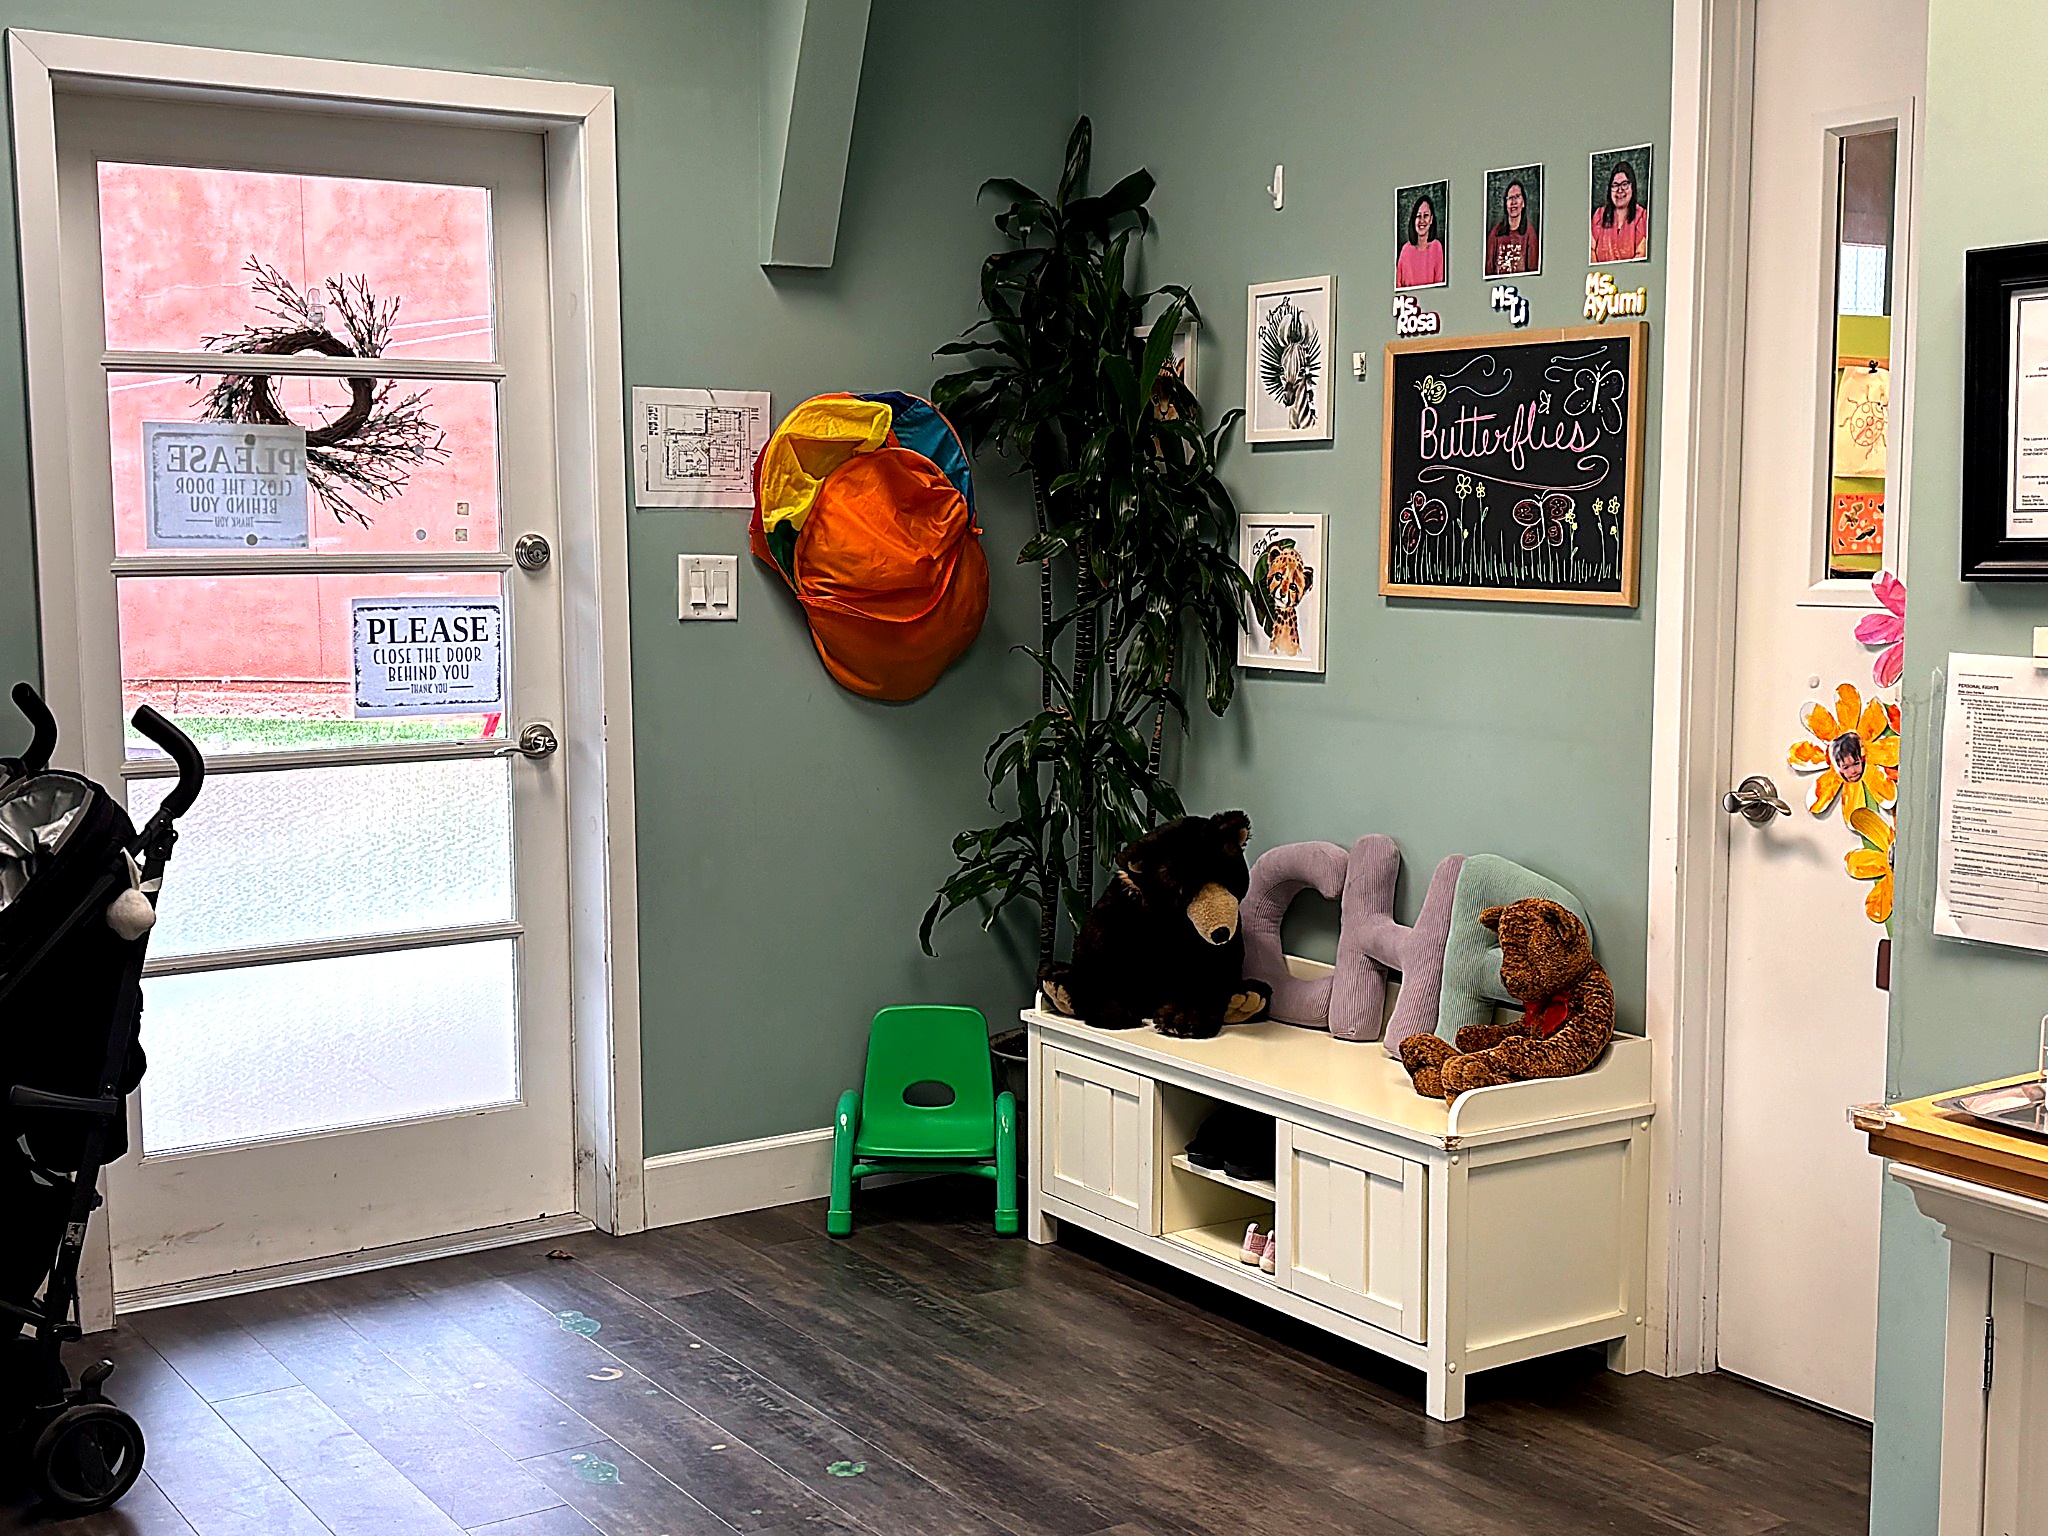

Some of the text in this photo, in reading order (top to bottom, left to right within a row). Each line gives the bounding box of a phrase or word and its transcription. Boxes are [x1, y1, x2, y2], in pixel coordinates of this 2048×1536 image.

[1586, 272, 1617, 296] Ms.
[1392, 295, 1419, 317] Ms.
[1492, 285, 1519, 308] Ms.
[1583, 287, 1647, 322] Ayumi
[1510, 298, 1527, 324] Li
[1396, 312, 1438, 335] Rosa
[1420, 400, 1600, 470] Butterflies
[366, 616, 489, 645] PLEASE
[373, 646, 482, 665] CLOSE THE DOOR
[388, 664, 470, 682] BEHIND YOU
[410, 682, 448, 694] THANK YOU
